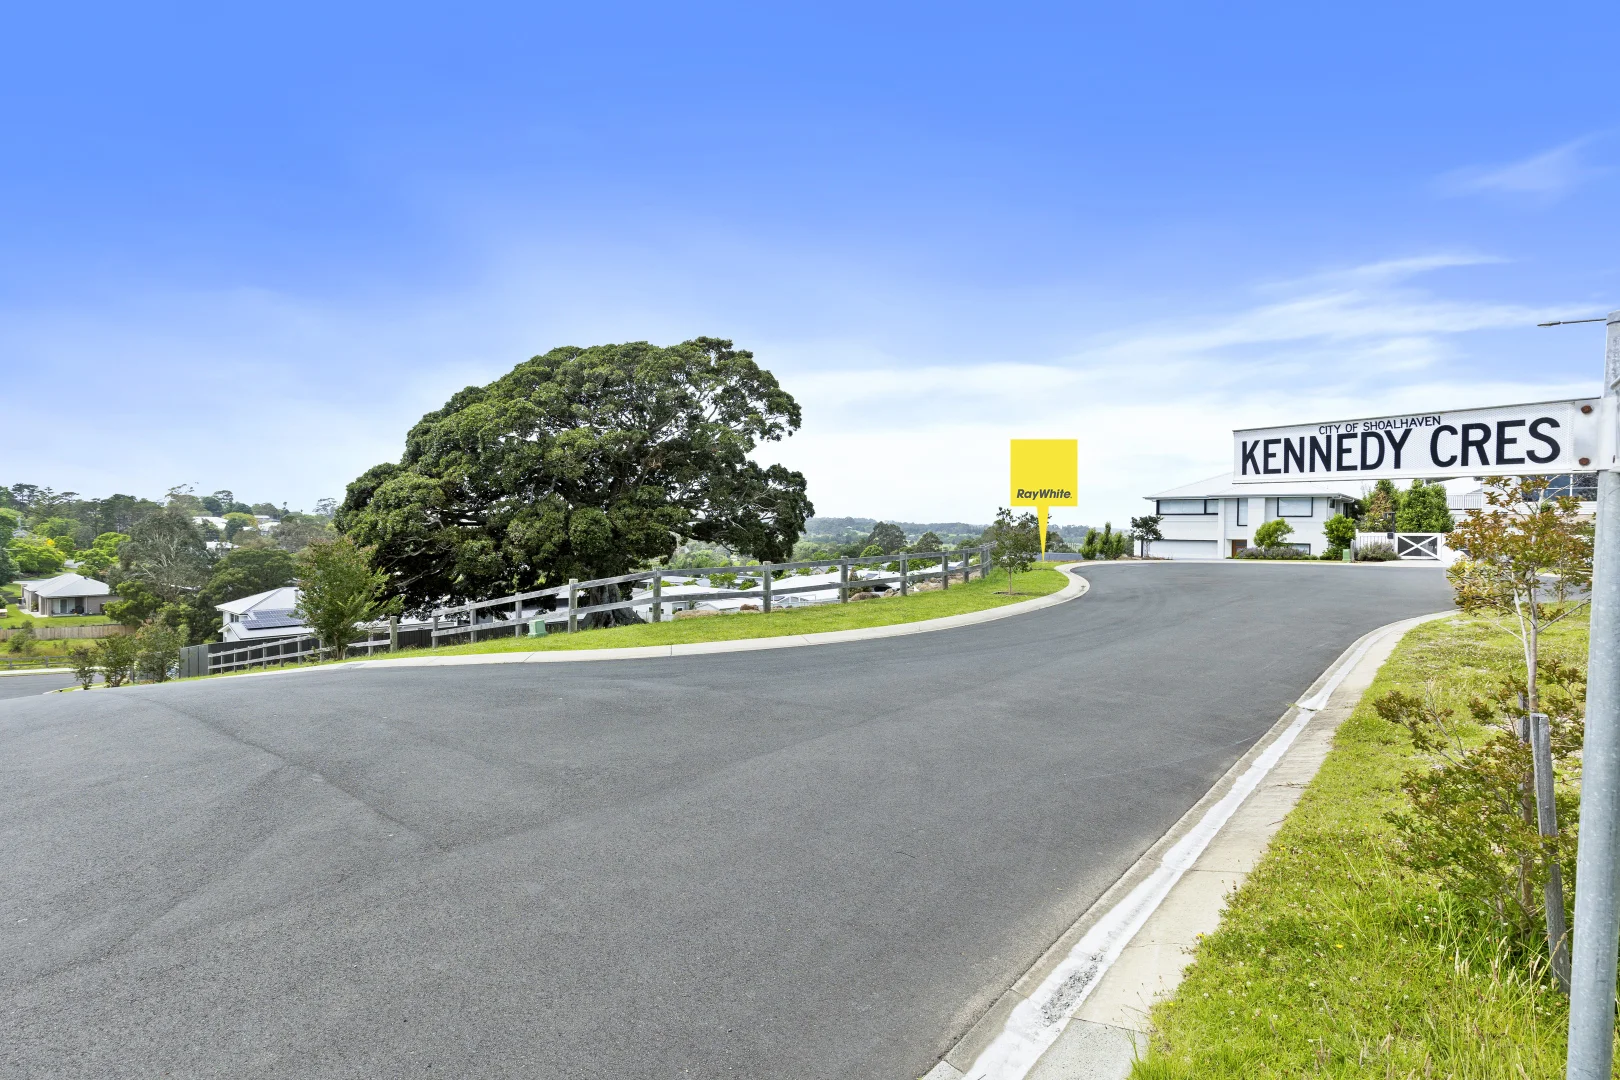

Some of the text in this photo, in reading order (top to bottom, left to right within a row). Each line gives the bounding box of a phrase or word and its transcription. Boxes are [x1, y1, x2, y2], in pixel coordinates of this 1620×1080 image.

[1318, 415, 1441, 435] CITY OF SHOALHAVEN
[1242, 417, 1561, 475] KENNEDY CRES
